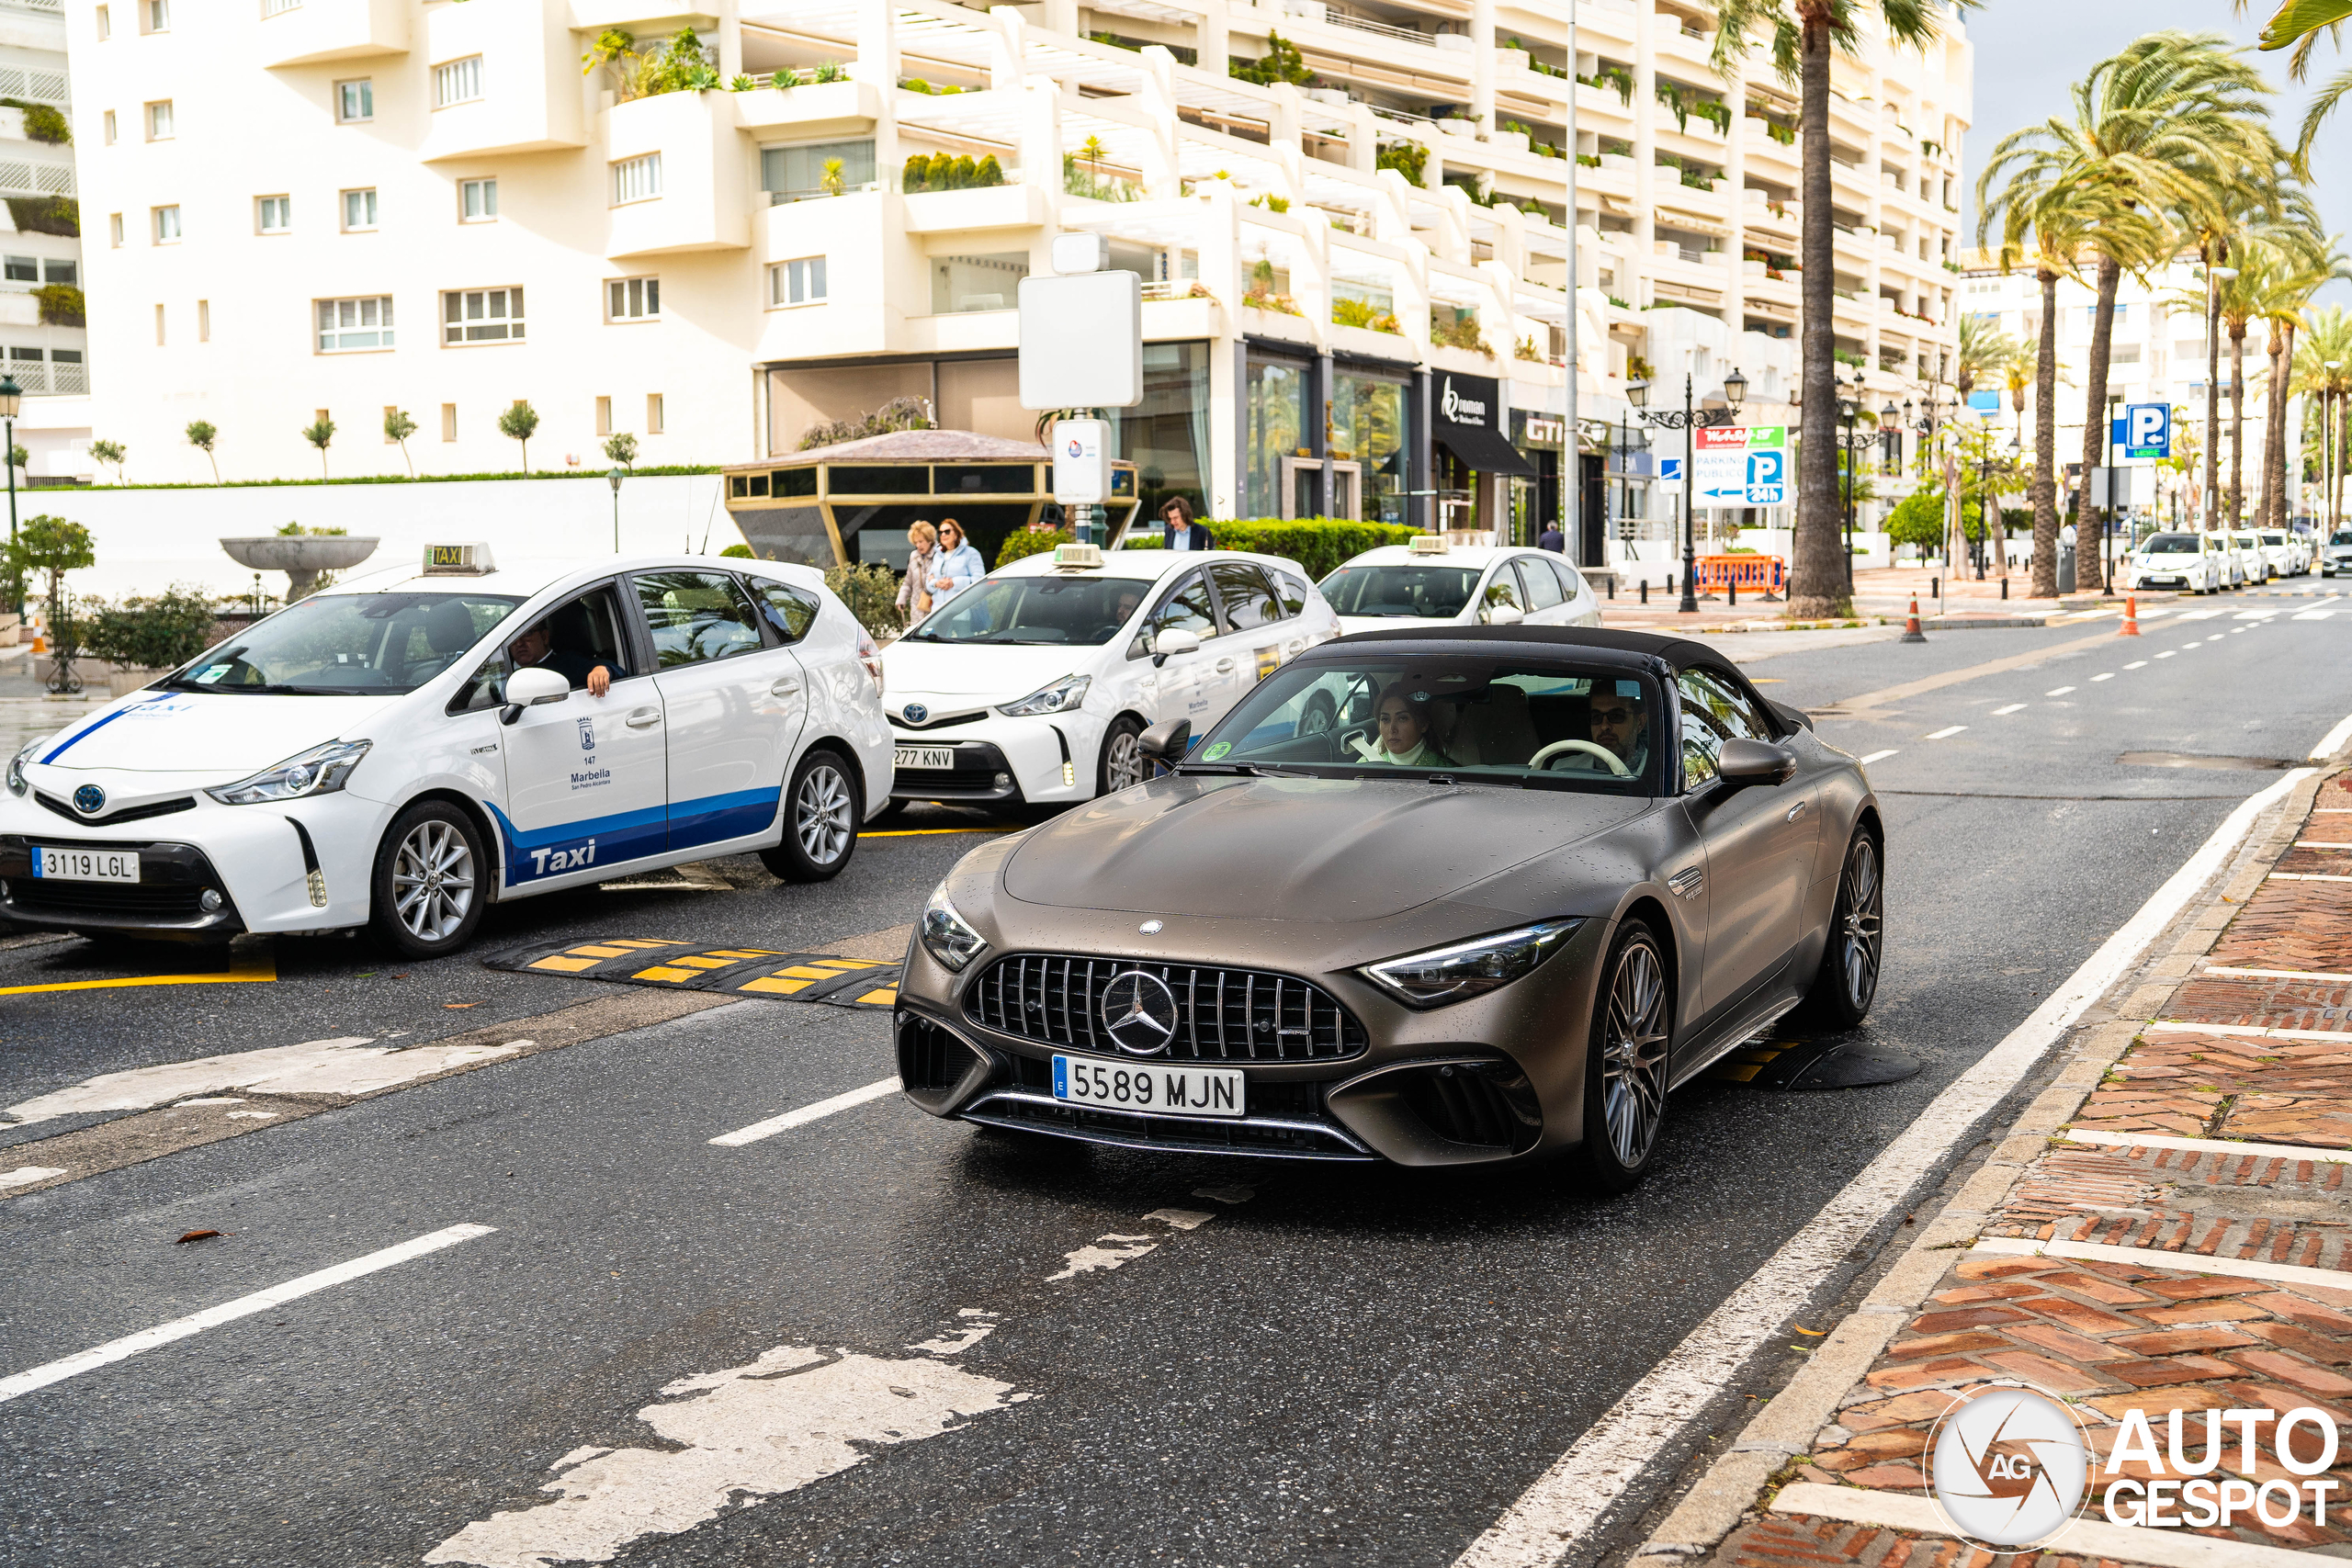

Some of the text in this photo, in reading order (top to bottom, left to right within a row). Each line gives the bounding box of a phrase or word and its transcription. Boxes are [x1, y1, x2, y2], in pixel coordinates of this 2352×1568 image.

[2132, 408, 2165, 446] P
[1696, 456, 1746, 465] PARKING
[1696, 468, 1746, 478] PUBLICO
[1754, 457, 1777, 484] P
[1751, 488, 1780, 502] 24h
[435, 547, 462, 564] TAXI
[584, 756, 595, 765] 147
[923, 750, 950, 766] KNV
[571, 769, 611, 783] Marbella
[530, 838, 595, 875] Taxi
[48, 853, 131, 878] 3119 LGL
[1057, 1064, 1235, 1110] E 5589 MJN
